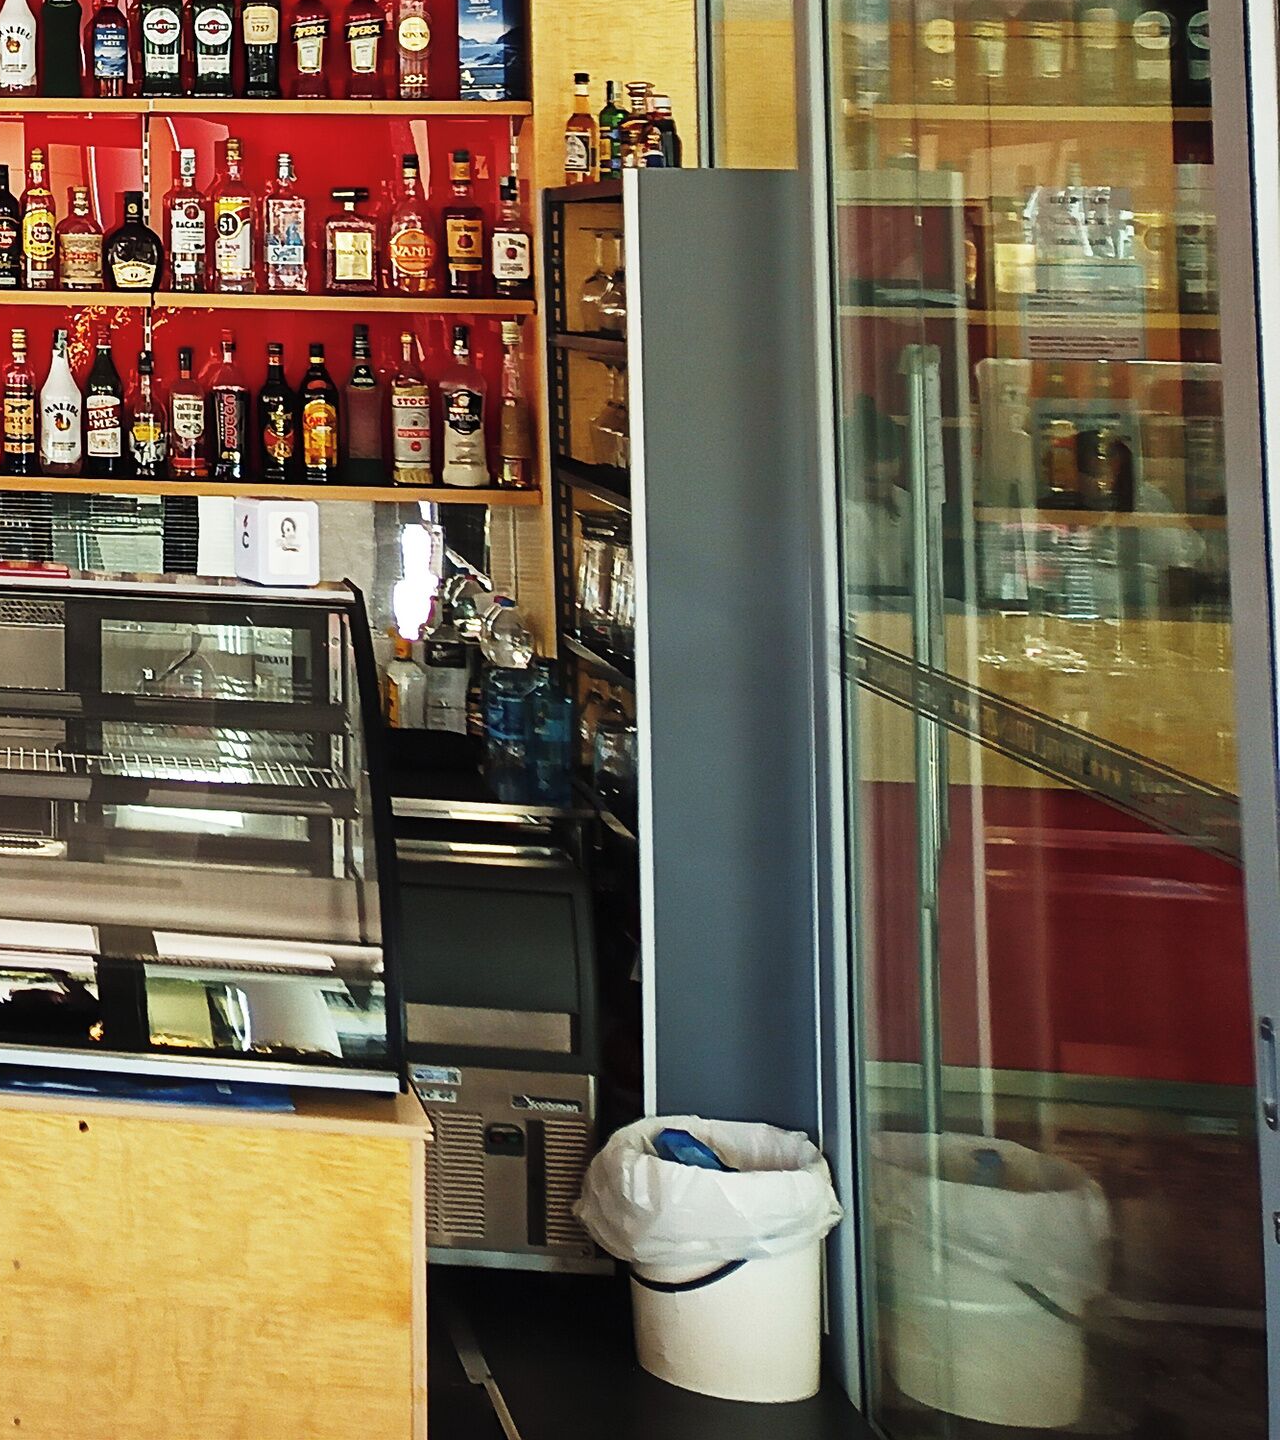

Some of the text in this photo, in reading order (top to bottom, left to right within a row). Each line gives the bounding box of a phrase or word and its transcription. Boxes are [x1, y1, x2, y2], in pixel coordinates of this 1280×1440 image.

[294, 24, 326, 38] APEROL
[348, 24, 381, 38] APEROL
[219, 218, 234, 232] 51
